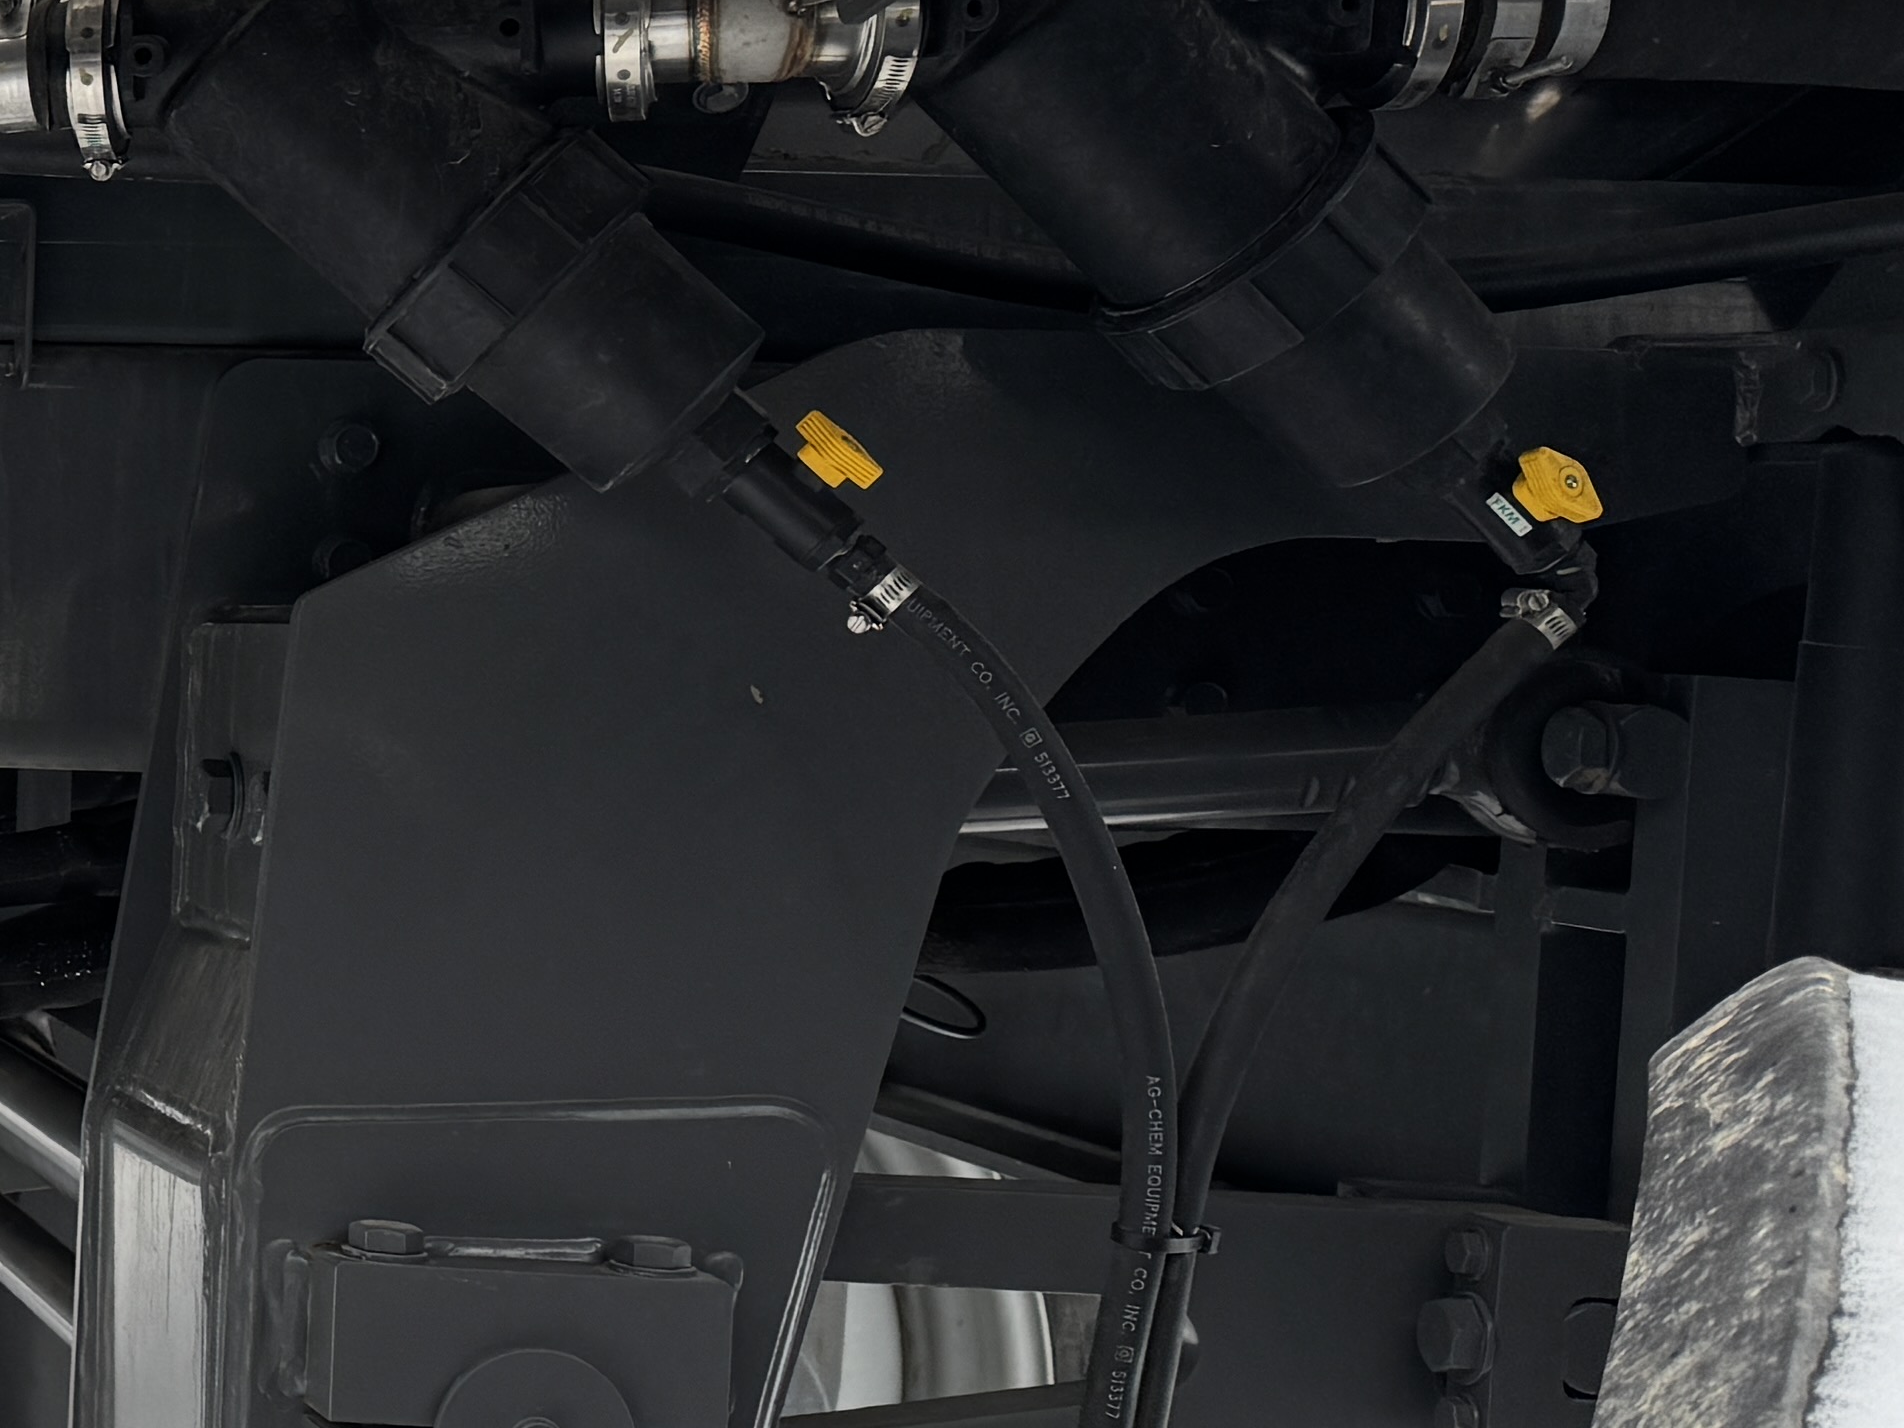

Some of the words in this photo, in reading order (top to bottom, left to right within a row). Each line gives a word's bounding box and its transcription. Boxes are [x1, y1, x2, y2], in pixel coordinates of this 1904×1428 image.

[1491, 497, 1521, 525] FKM
[906, 598, 971, 656] UIPMENT
[994, 692, 1021, 725] INC.
[1145, 1074, 1164, 1157] AG-CHEM
[1139, 1164, 1162, 1260] EQUIPMET
